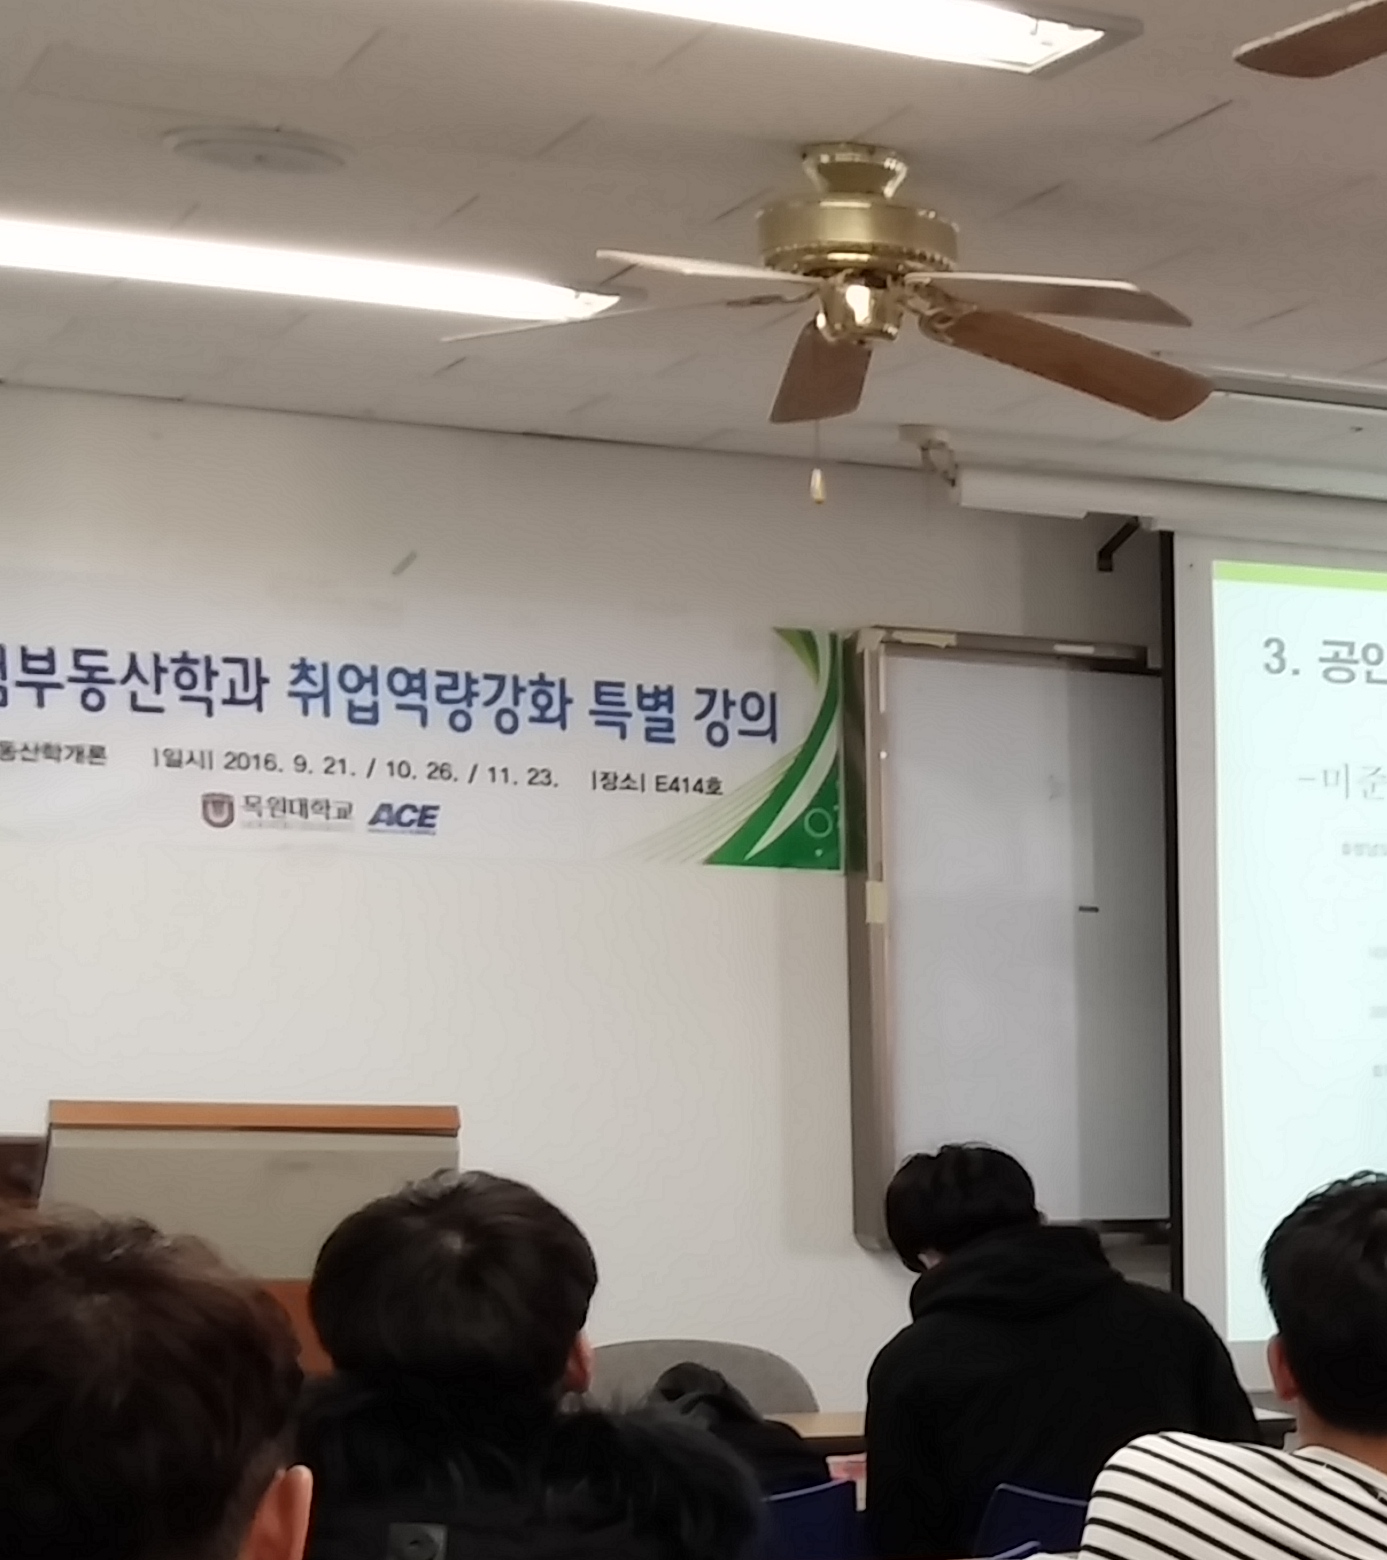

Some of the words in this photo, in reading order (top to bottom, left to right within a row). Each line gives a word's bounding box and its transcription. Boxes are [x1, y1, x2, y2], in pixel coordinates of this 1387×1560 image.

[1263, 637, 1300, 676] 3.
[0, 643, 271, 719] 부동산학과
[287, 656, 574, 736] 취업역량강화
[588, 680, 676, 745] 특별
[694, 687, 778, 748] 강의
[223, 750, 284, 773] 2016.
[293, 754, 313, 775] 9.
[323, 755, 356, 777] 21.
[386, 759, 417, 780] 10.
[426, 761, 458, 783] 26.
[487, 766, 518, 786] 11.
[527, 767, 559, 788] 23.
[655, 774, 724, 796] E414호
[243, 795, 354, 820] 목원대학교
[367, 802, 441, 829] ACE
